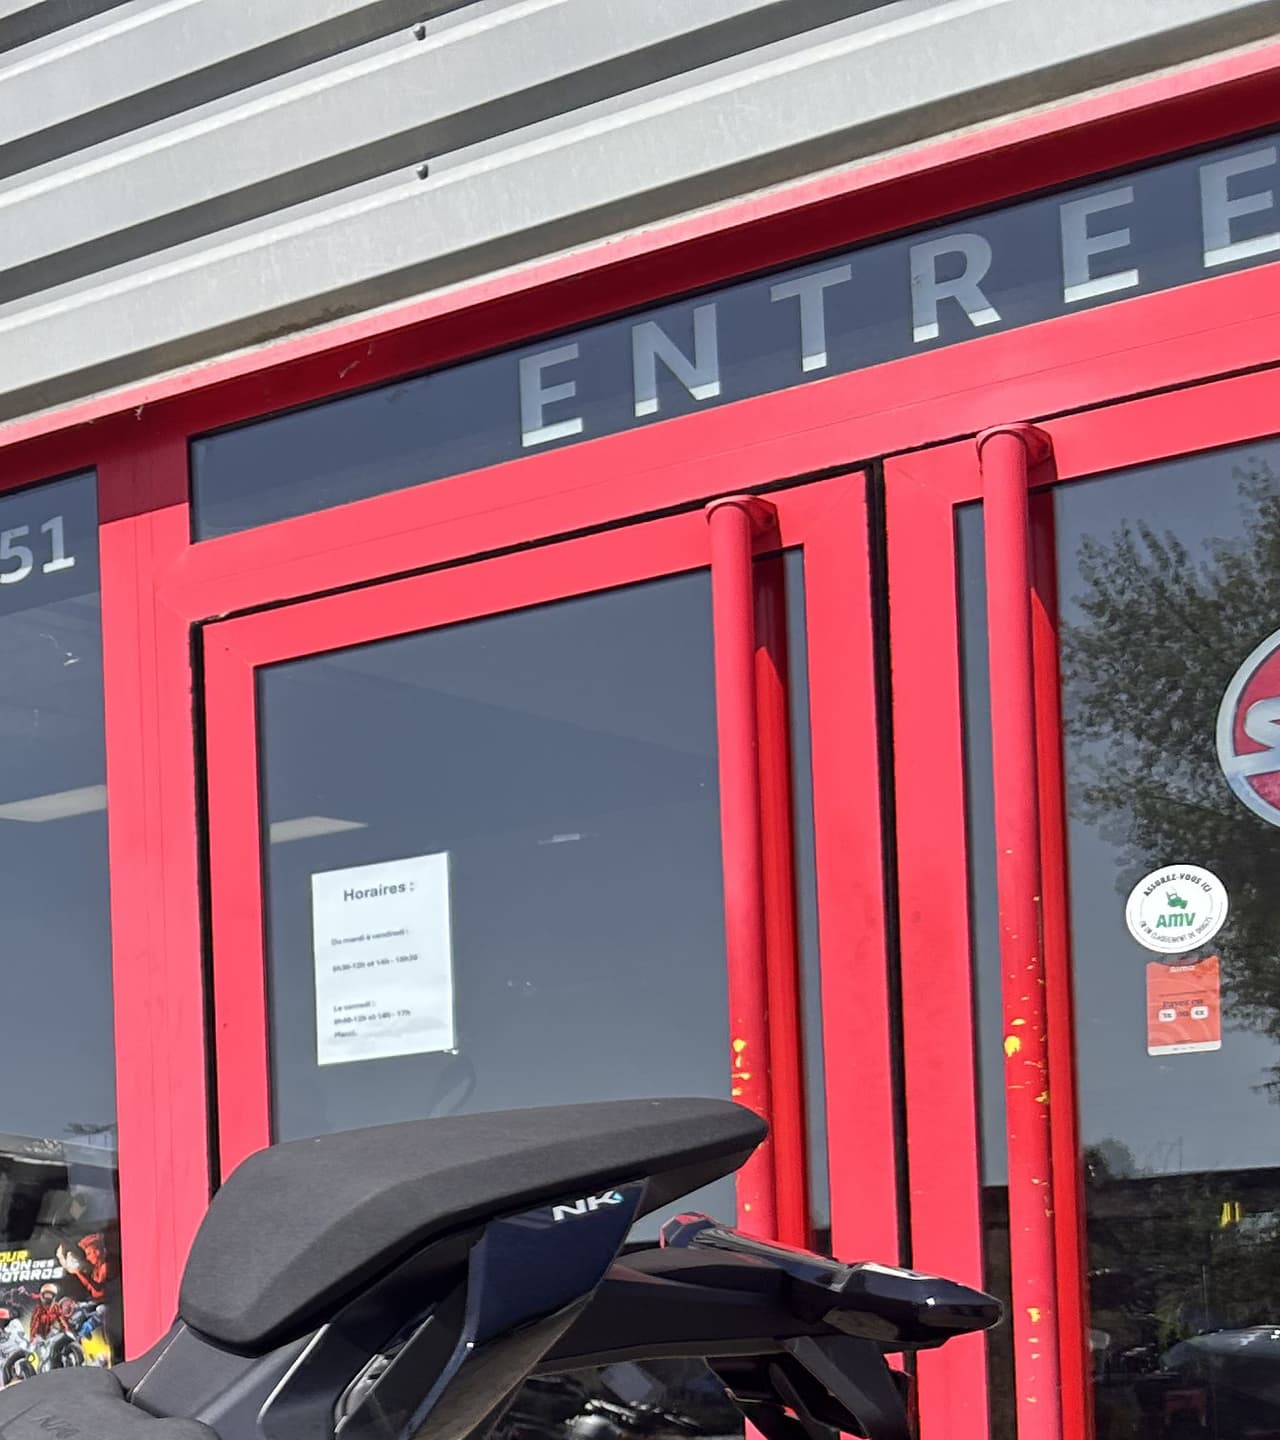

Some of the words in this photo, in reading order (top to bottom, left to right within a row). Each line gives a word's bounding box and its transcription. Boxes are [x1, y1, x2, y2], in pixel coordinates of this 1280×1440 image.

[518, 146, 1280, 448] ENTREE
[343, 883, 406, 901] Horaires
[1156, 912, 1196, 928] AMV
[551, 1190, 624, 1221] NK
